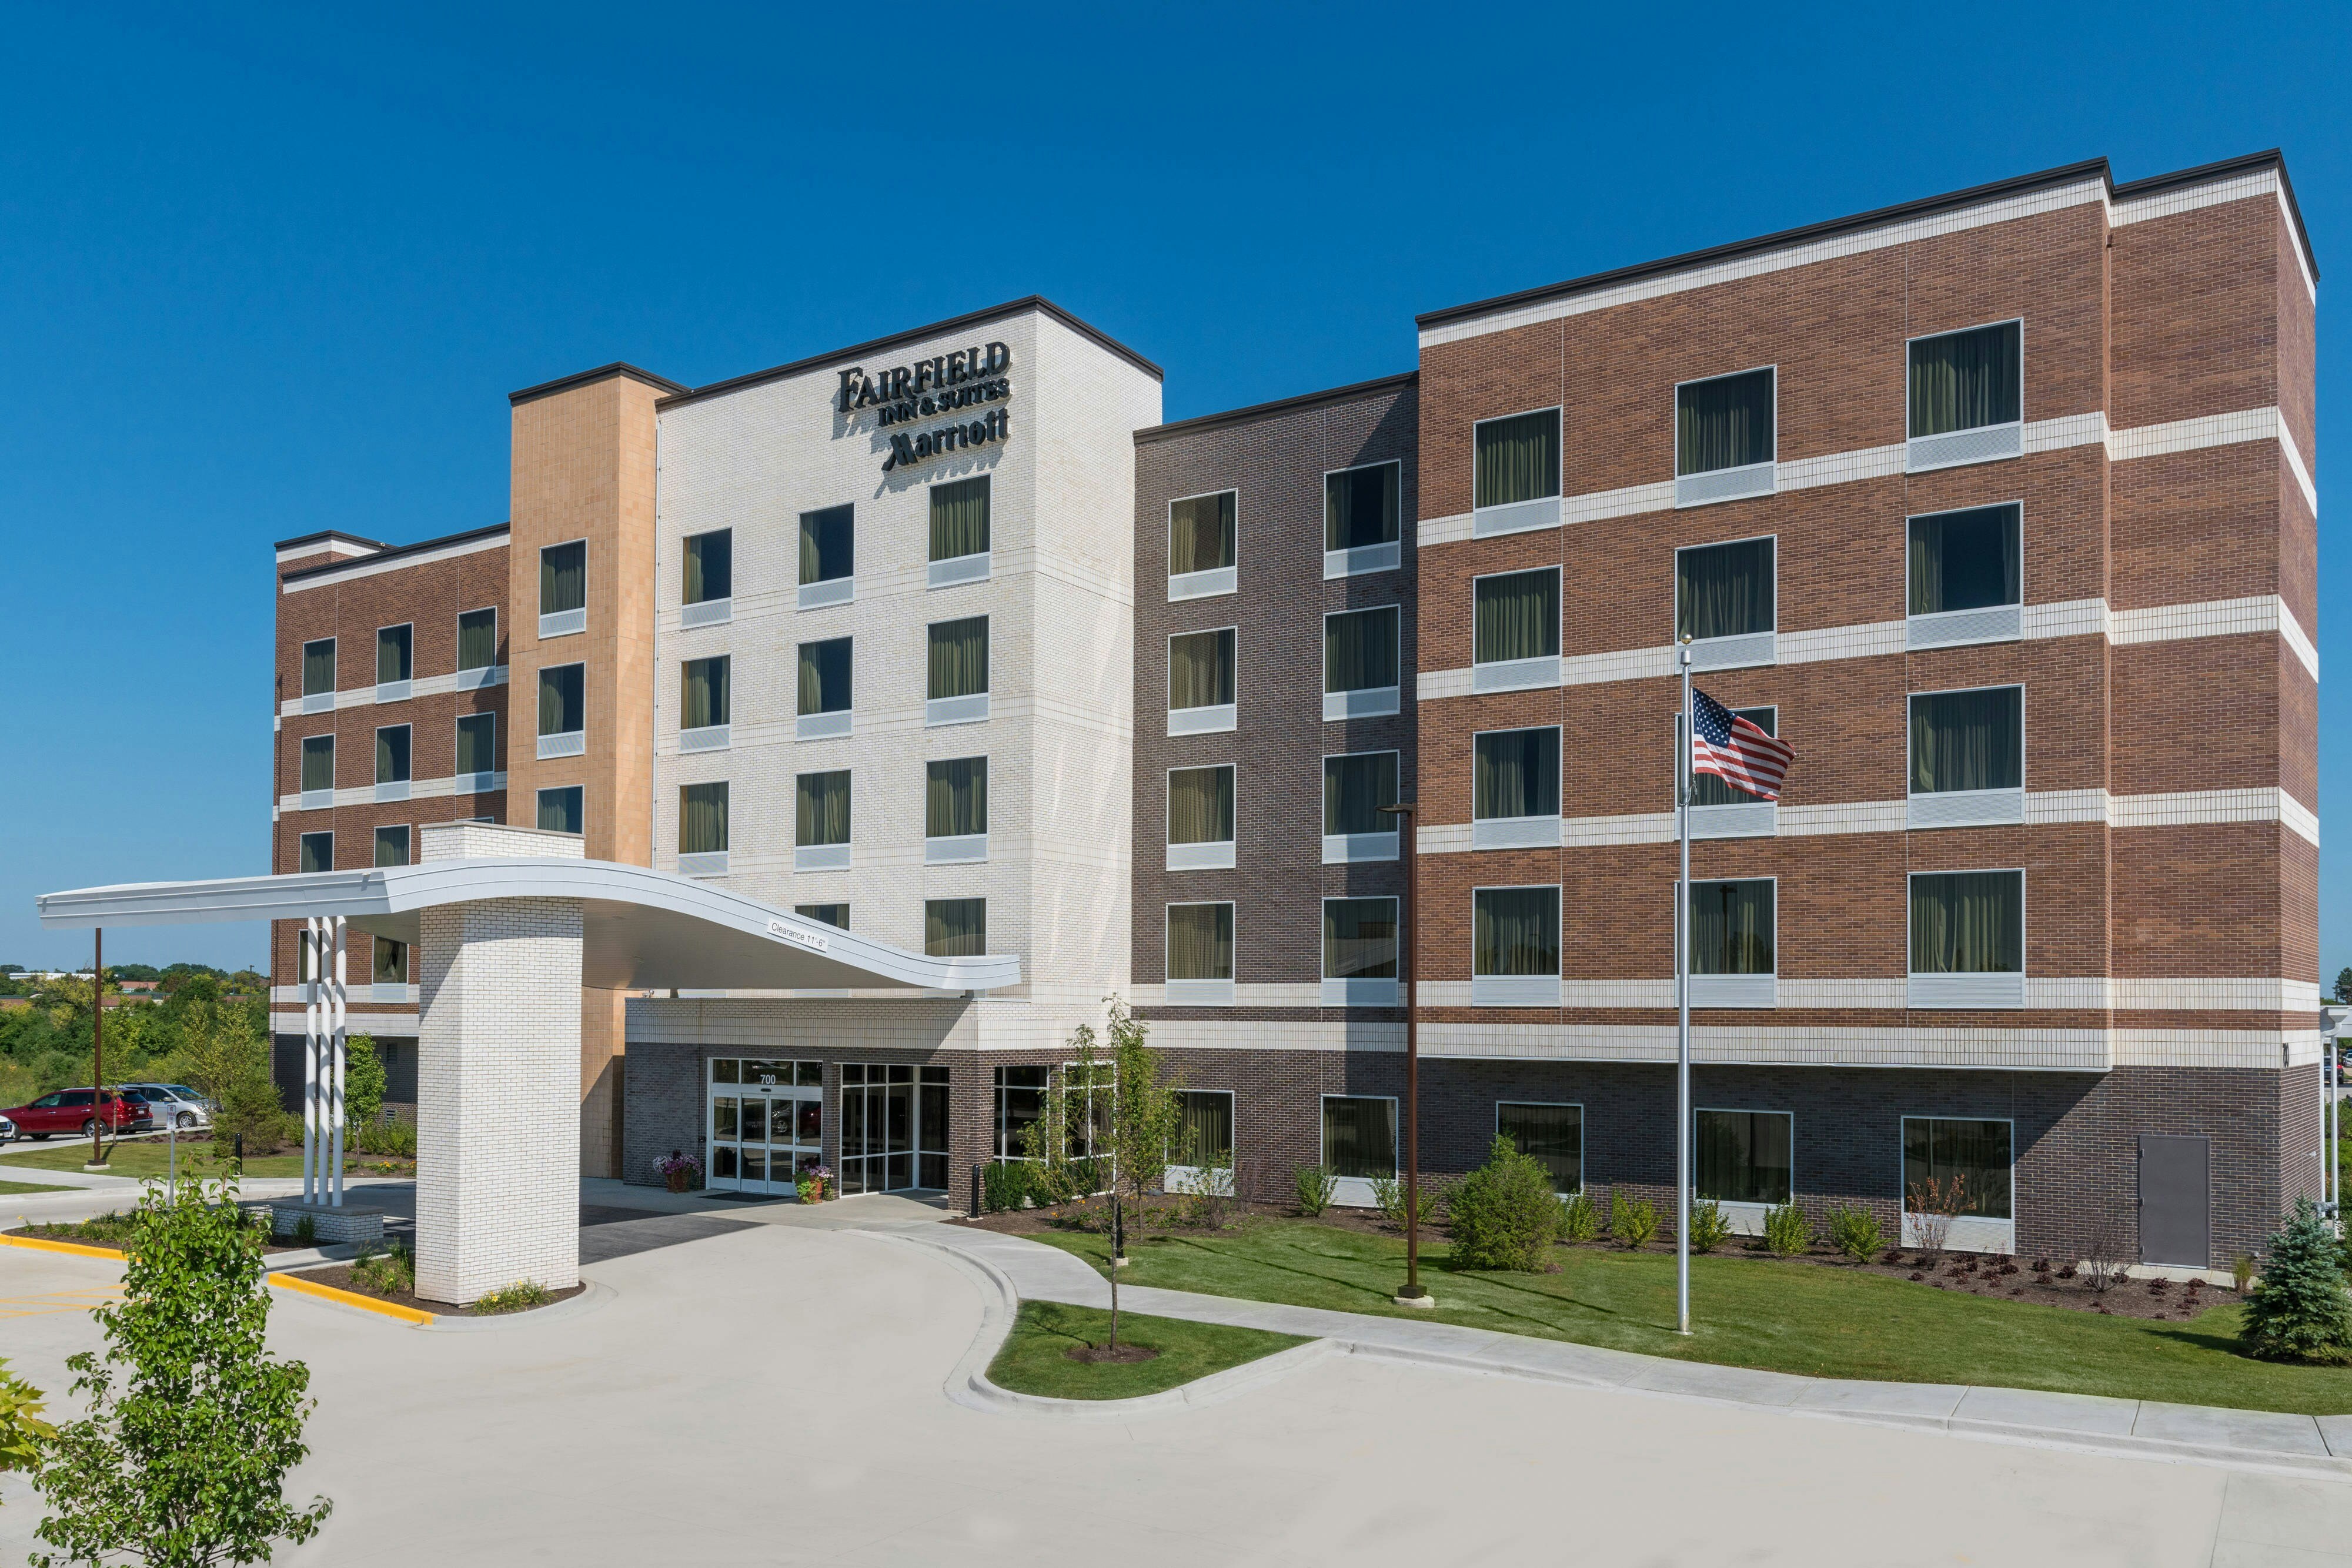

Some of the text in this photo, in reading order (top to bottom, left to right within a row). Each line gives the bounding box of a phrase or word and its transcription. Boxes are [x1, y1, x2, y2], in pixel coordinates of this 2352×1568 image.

[837, 341, 1011, 412] FAIRFIELD
[877, 399, 920, 427] INN
[937, 377, 1010, 412] SUITES
[881, 407, 1010, 471] Marriott
[771, 922, 804, 941] Clearance
[760, 1074, 776, 1085] 700
